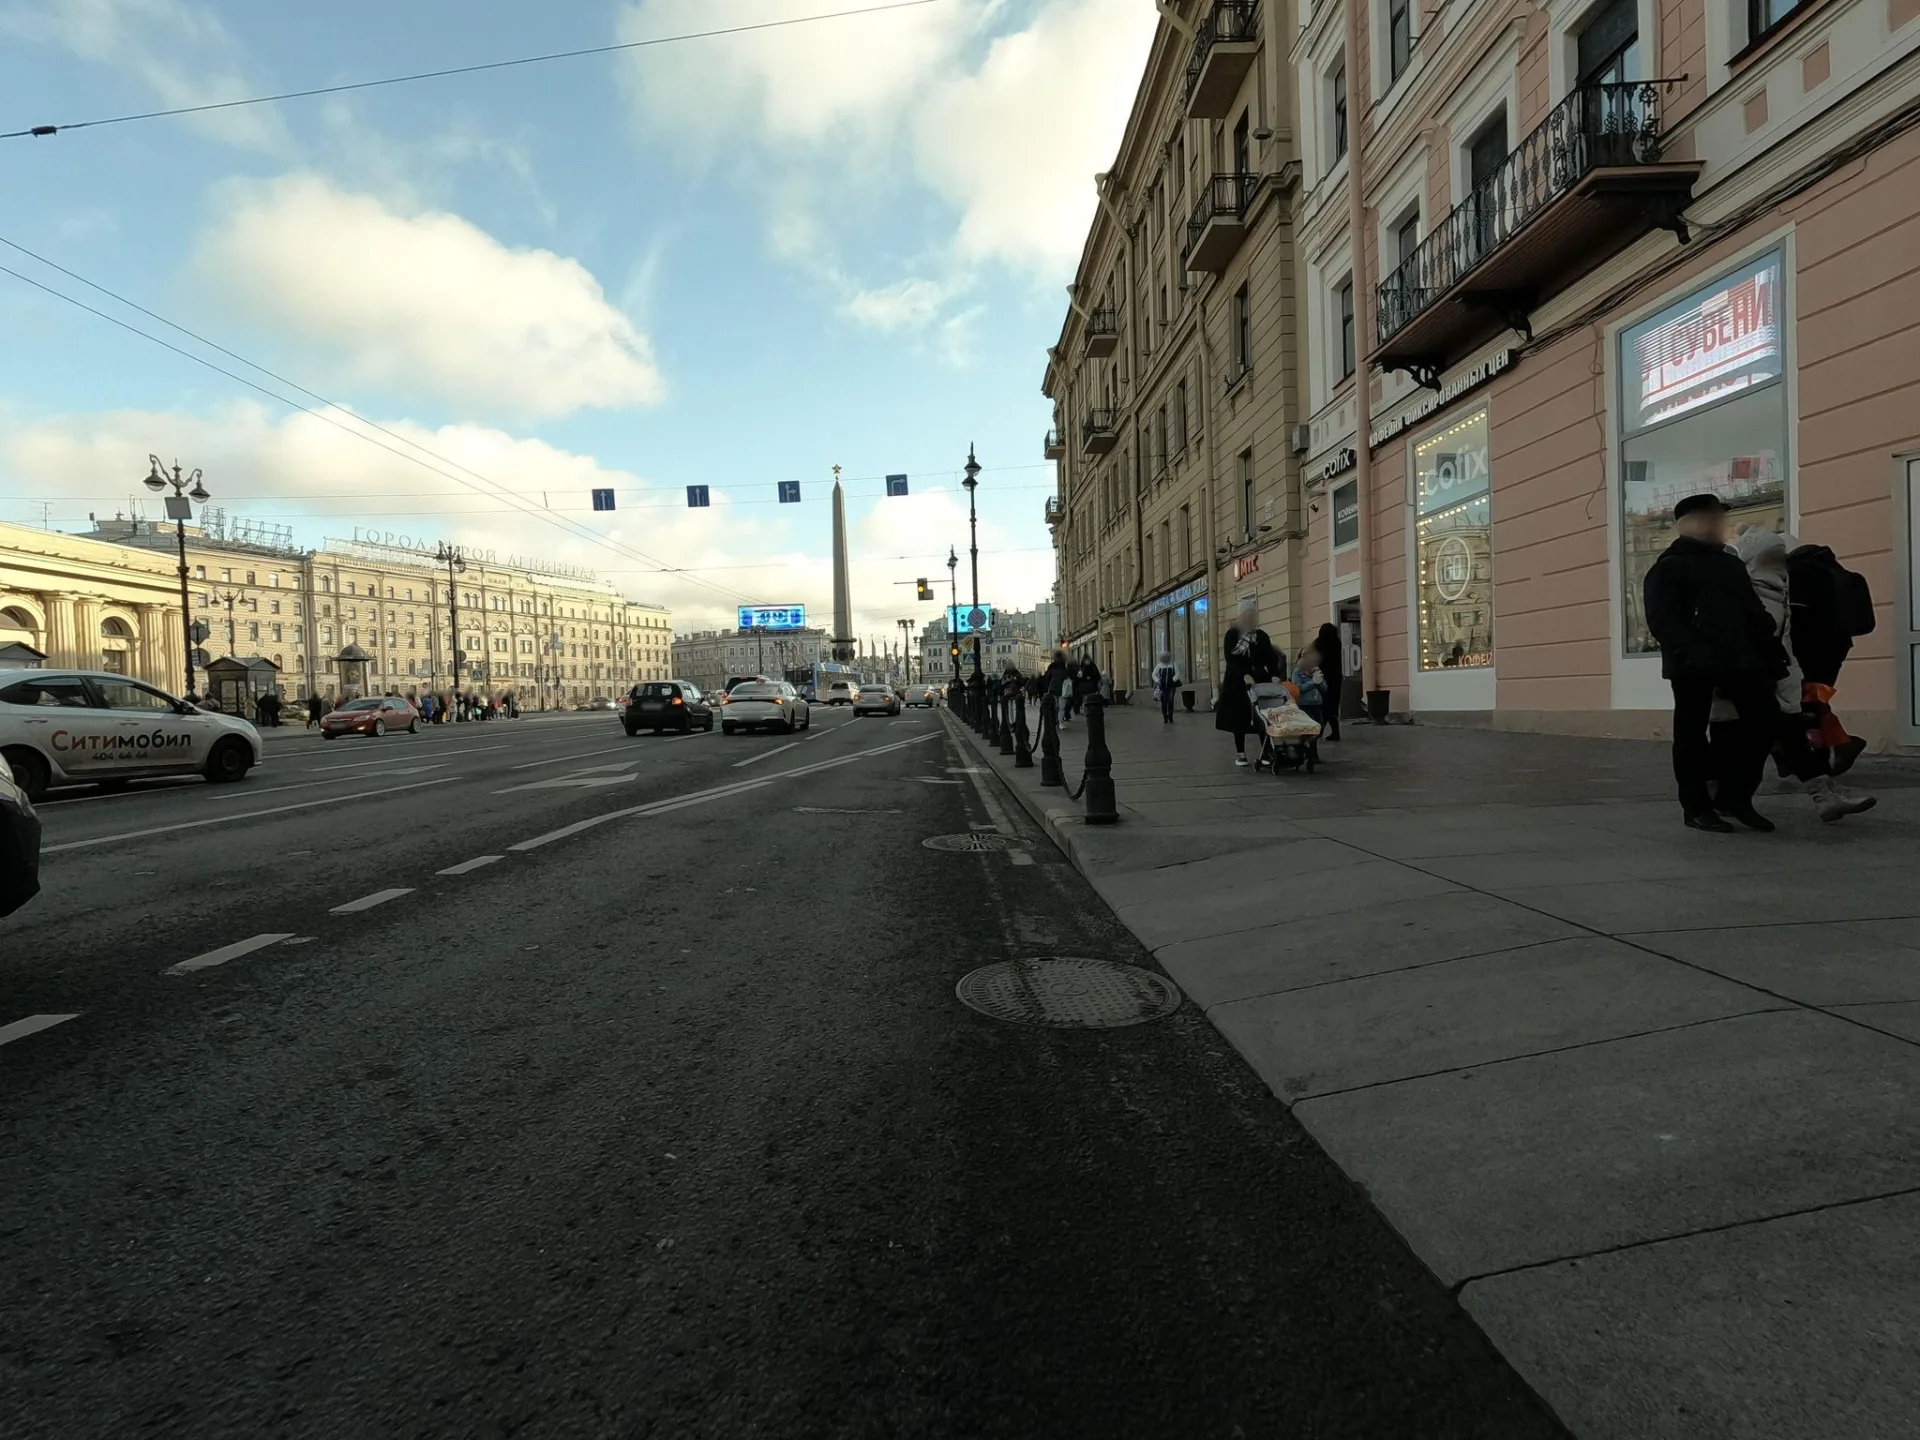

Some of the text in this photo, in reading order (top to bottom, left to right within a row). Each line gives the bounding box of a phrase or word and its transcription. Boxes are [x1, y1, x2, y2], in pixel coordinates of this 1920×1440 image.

[1369, 349, 1509, 448] КОФЕЙНЯ ФИКСИРОВАННЫХ ЦЕН
[51, 729, 191, 751] Ситимобил
[92, 752, 114, 761] 404
